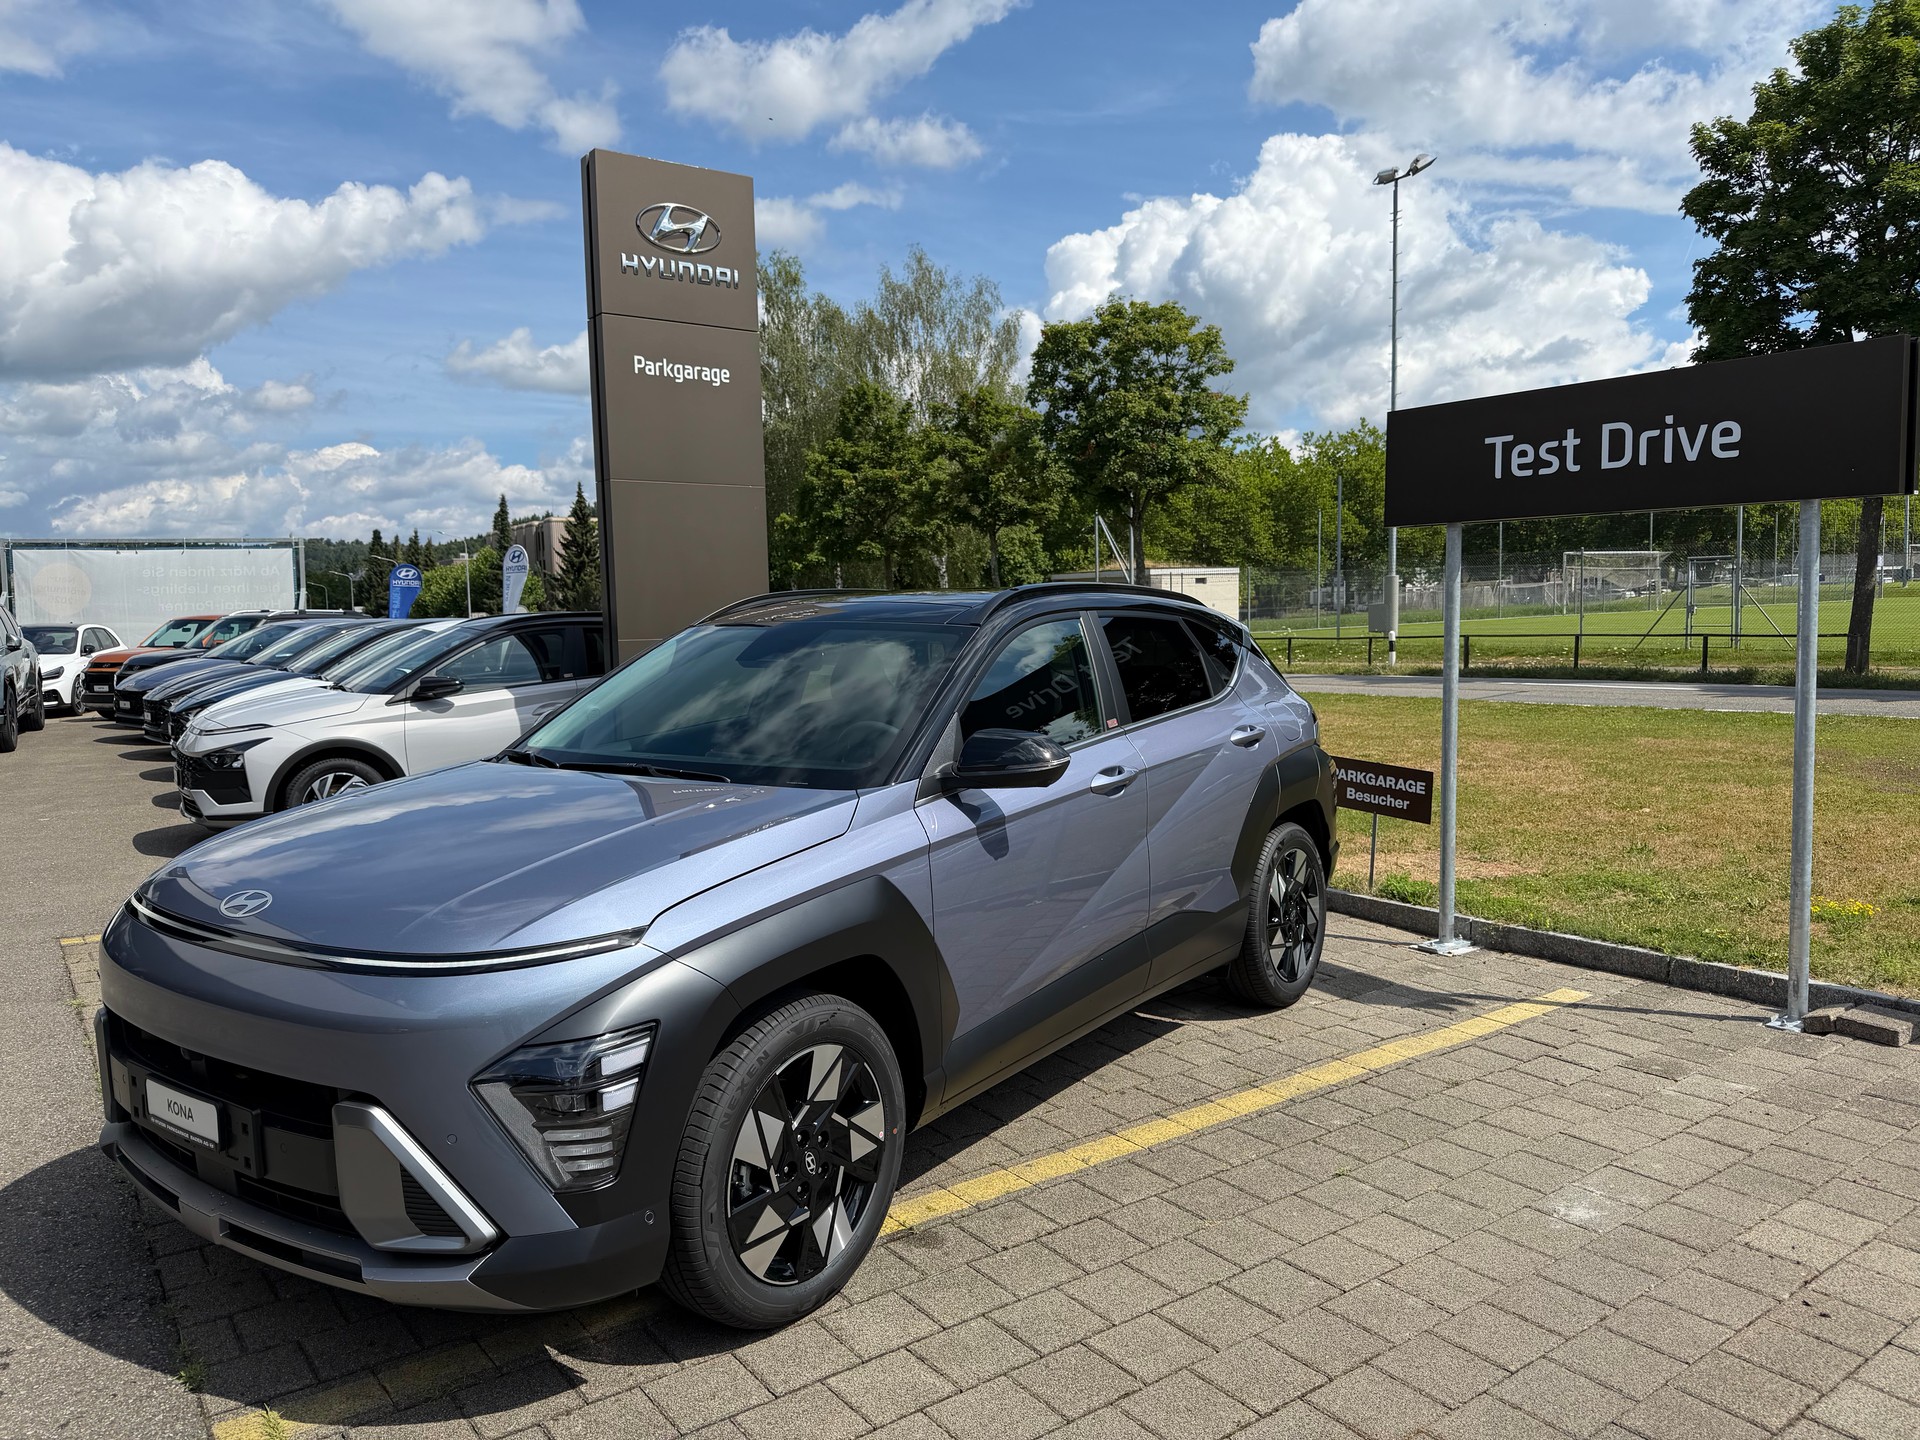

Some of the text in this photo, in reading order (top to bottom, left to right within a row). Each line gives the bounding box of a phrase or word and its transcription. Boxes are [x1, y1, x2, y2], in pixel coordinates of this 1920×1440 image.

[620, 252, 739, 289] HYUNDAI
[634, 355, 730, 387] Parkgarage
[1485, 414, 1742, 479] Test Drive
[1346, 787, 1410, 810] Besucher
[719, 1049, 770, 1131] NEXEN
[166, 1098, 195, 1122] KONA
